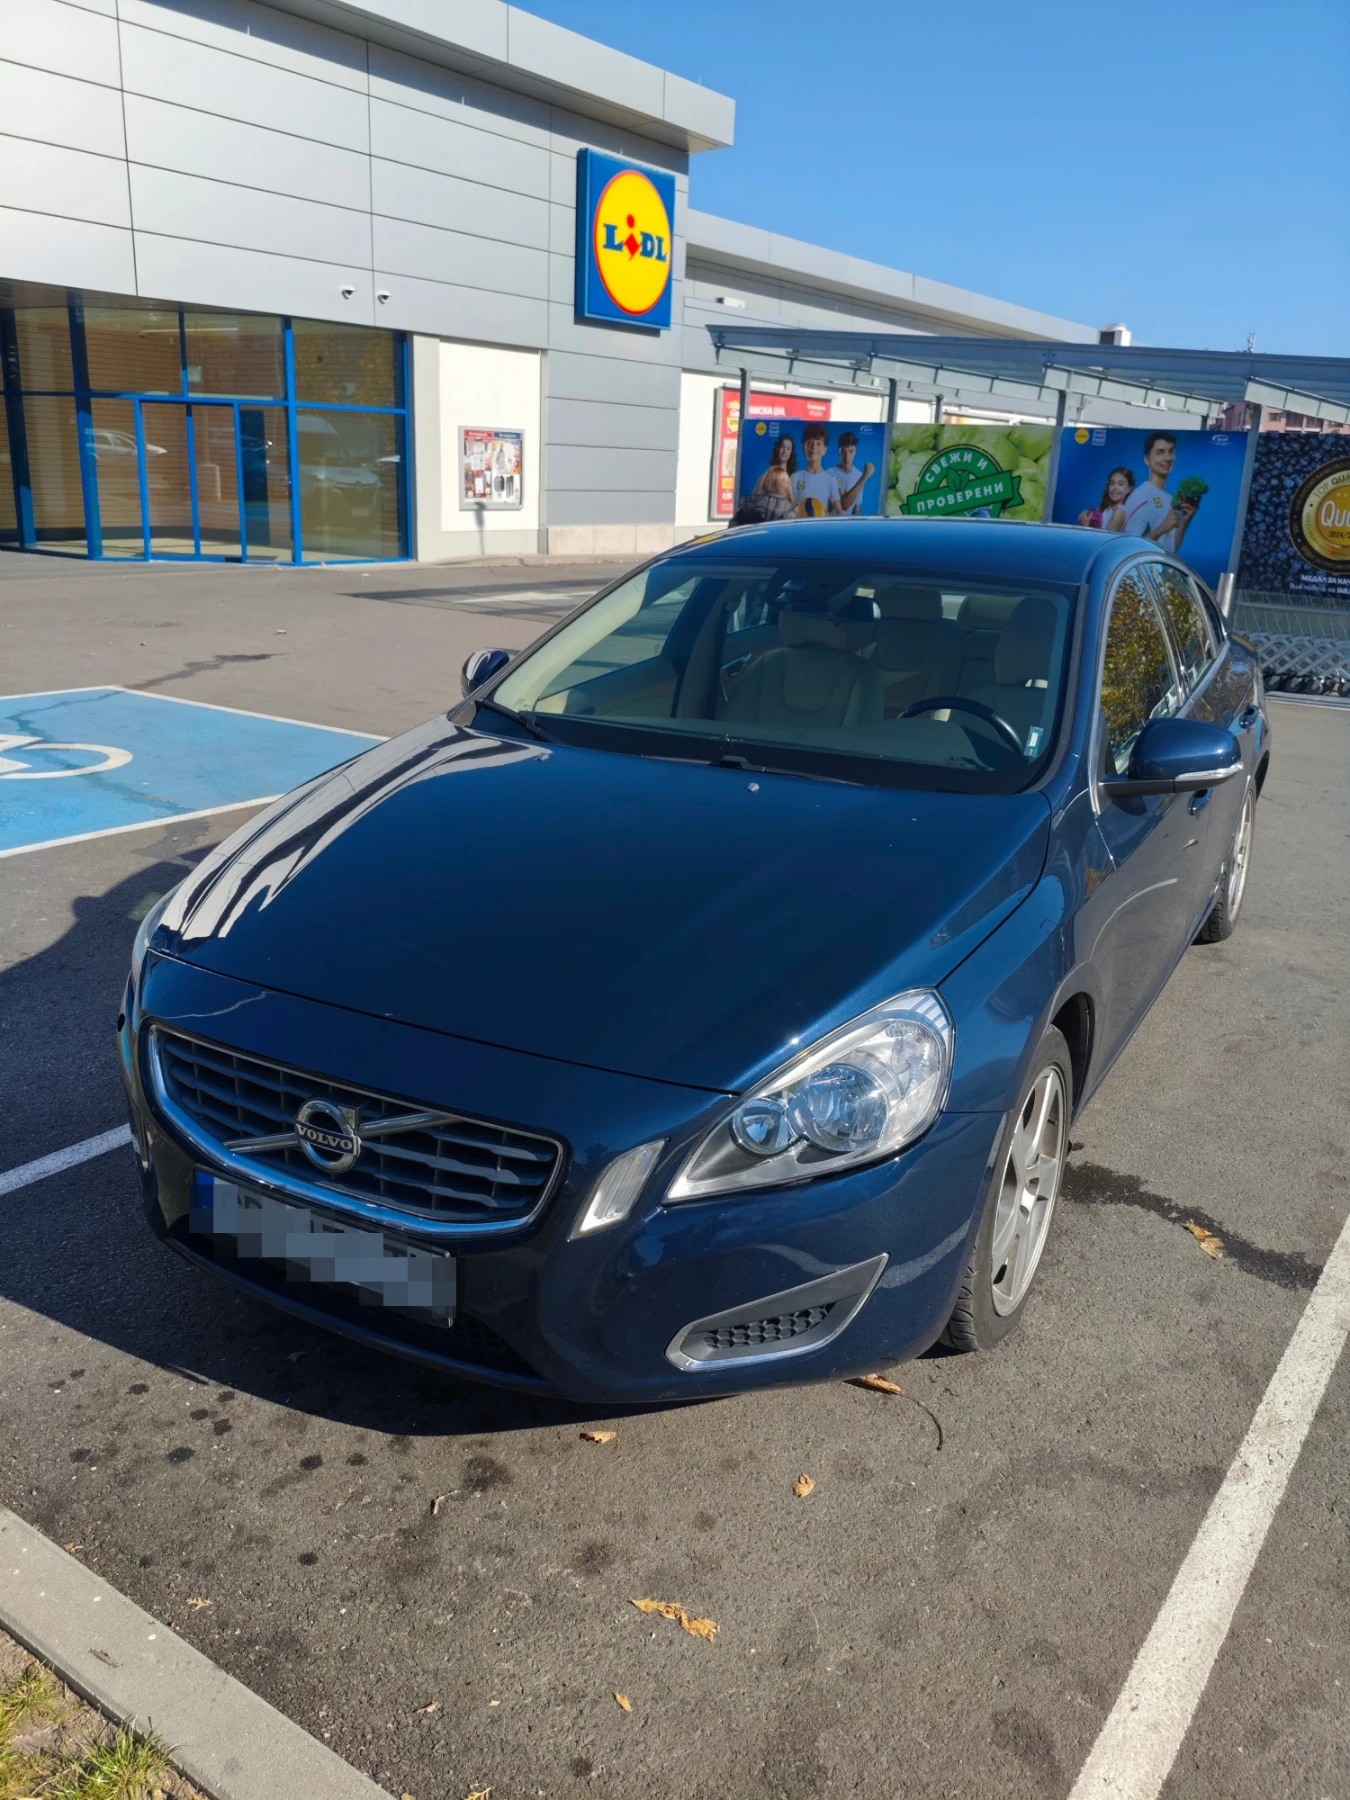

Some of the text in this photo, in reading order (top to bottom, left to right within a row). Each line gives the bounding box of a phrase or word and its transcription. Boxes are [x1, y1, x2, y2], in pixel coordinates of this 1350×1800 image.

[603, 214, 668, 262] LIDL
[925, 452, 988, 483] СВЕЖИ И
[917, 482, 1004, 512] ПРОВЕРЕНИ
[1313, 482, 1329, 498] TOP
[1301, 575, 1327, 583] МЕДАЛ
[296, 1124, 353, 1150] VOLVO
